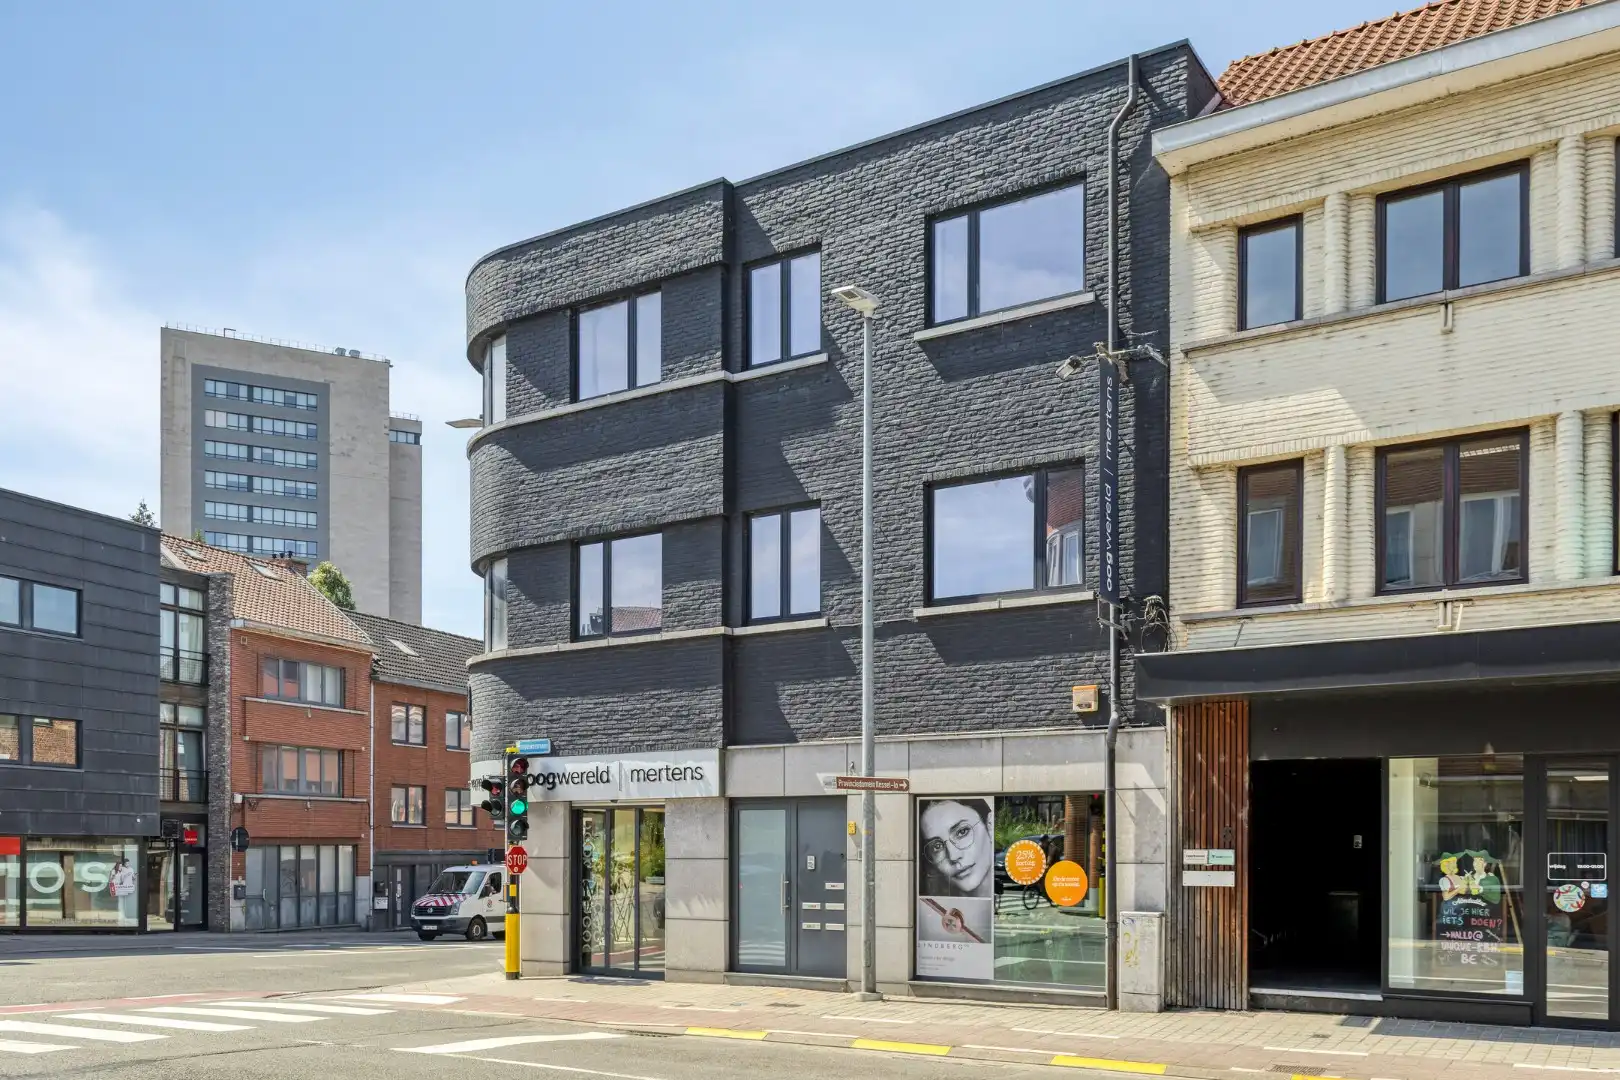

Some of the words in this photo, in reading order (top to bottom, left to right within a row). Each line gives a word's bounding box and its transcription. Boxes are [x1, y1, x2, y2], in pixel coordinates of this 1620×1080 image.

[1105, 375, 1113, 461] mertens
[1104, 483, 1114, 592] oogwereld
[527, 766, 611, 790] oogwereld
[630, 764, 704, 782] mertens
[508, 854, 527, 866] STOP
[1016, 850, 1035, 860] 25%
[1461, 953, 1478, 965] BE
